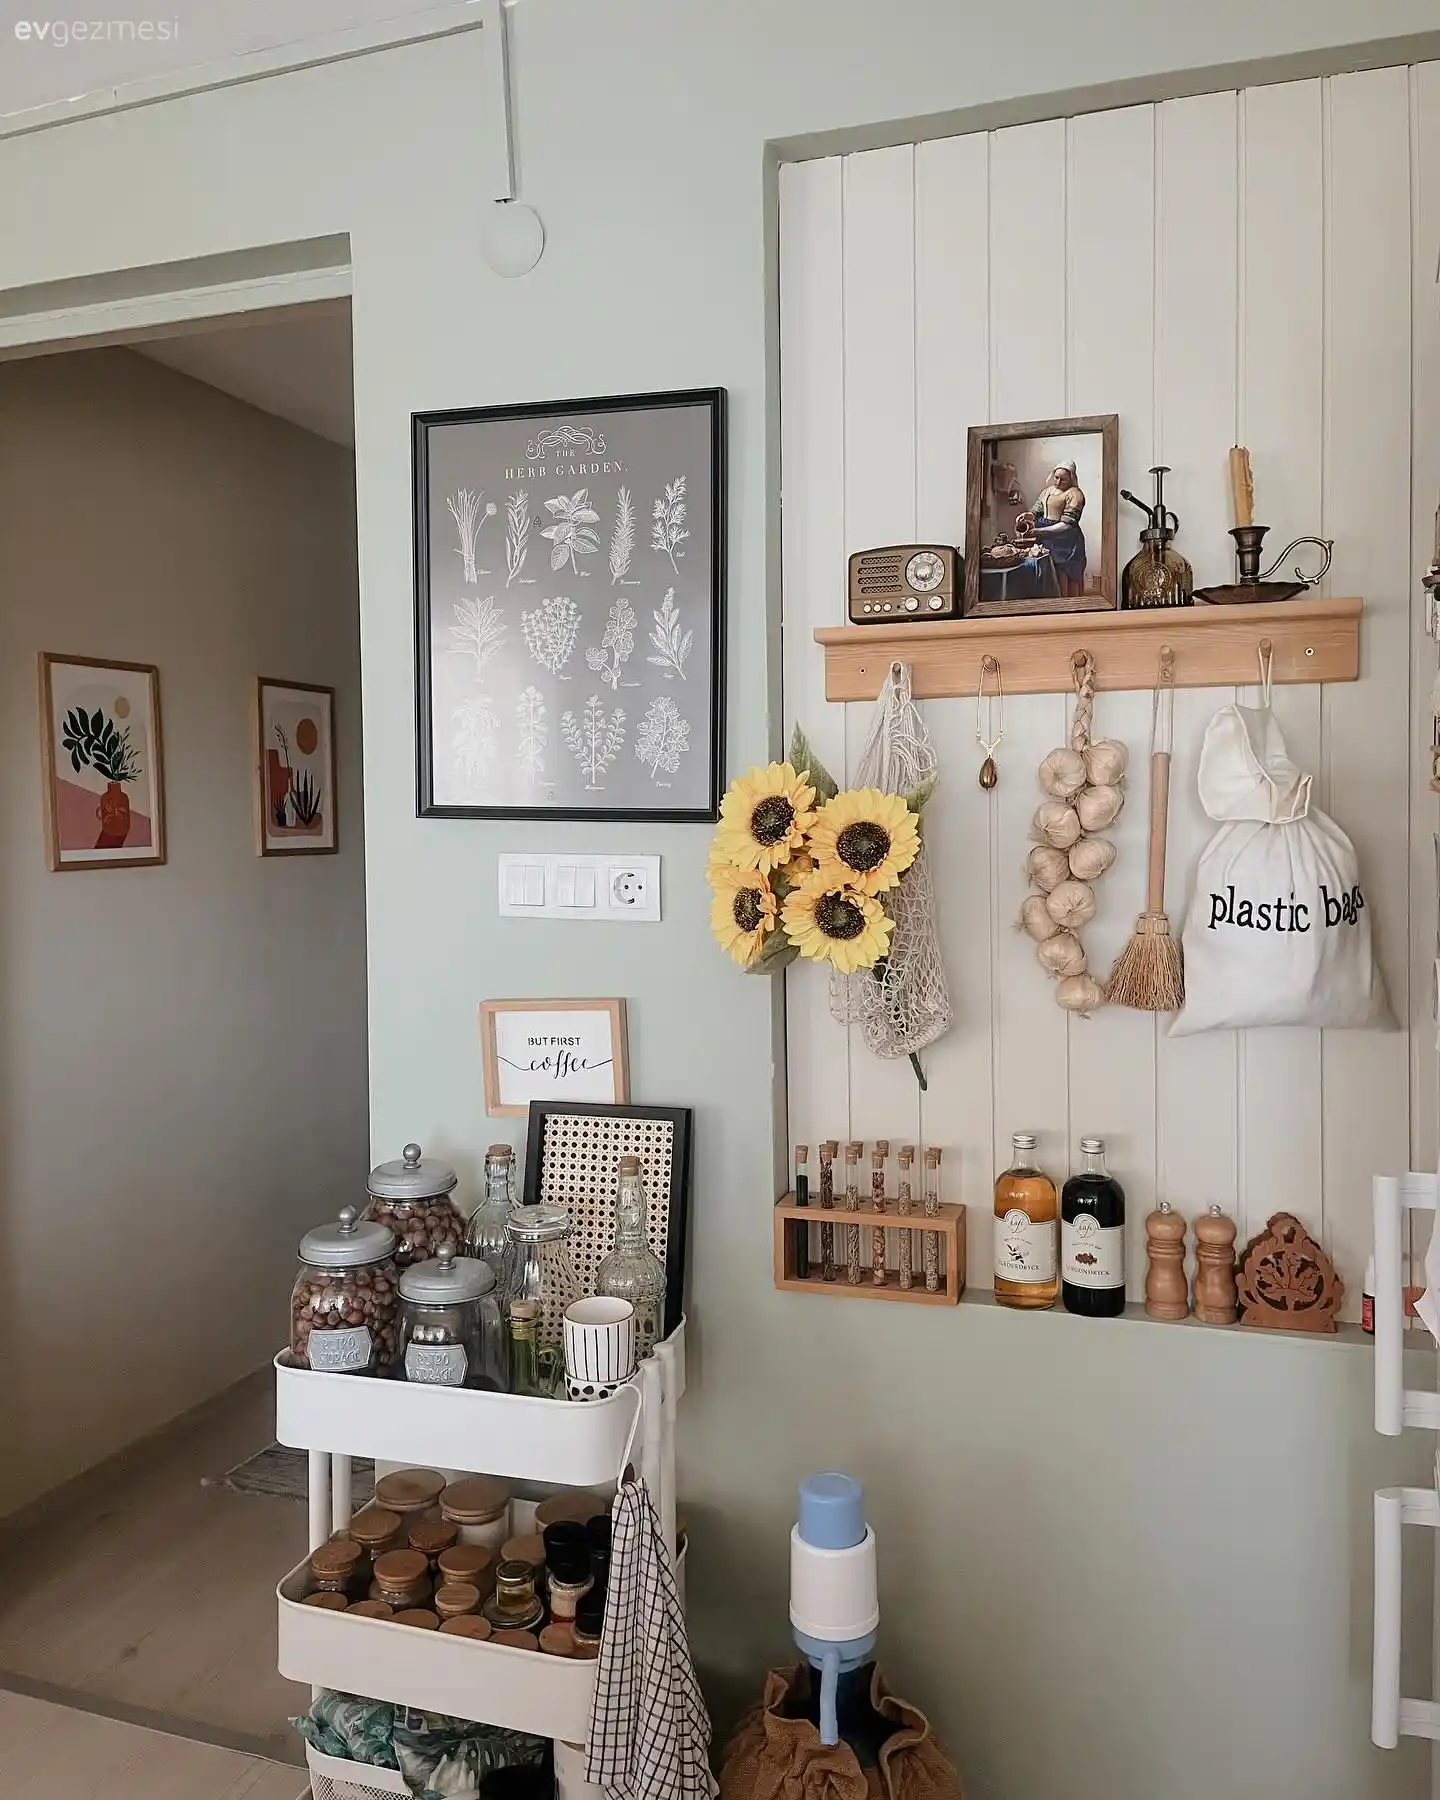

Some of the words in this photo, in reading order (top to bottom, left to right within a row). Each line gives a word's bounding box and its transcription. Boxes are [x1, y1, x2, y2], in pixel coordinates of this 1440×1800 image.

[556, 449, 576, 458] THE
[504, 466, 546, 480] HERB
[1208, 885, 1311, 933] plastic
[527, 1037, 548, 1046] BUT
[550, 1037, 581, 1046] FIRST
[512, 1049, 602, 1079] coffee
